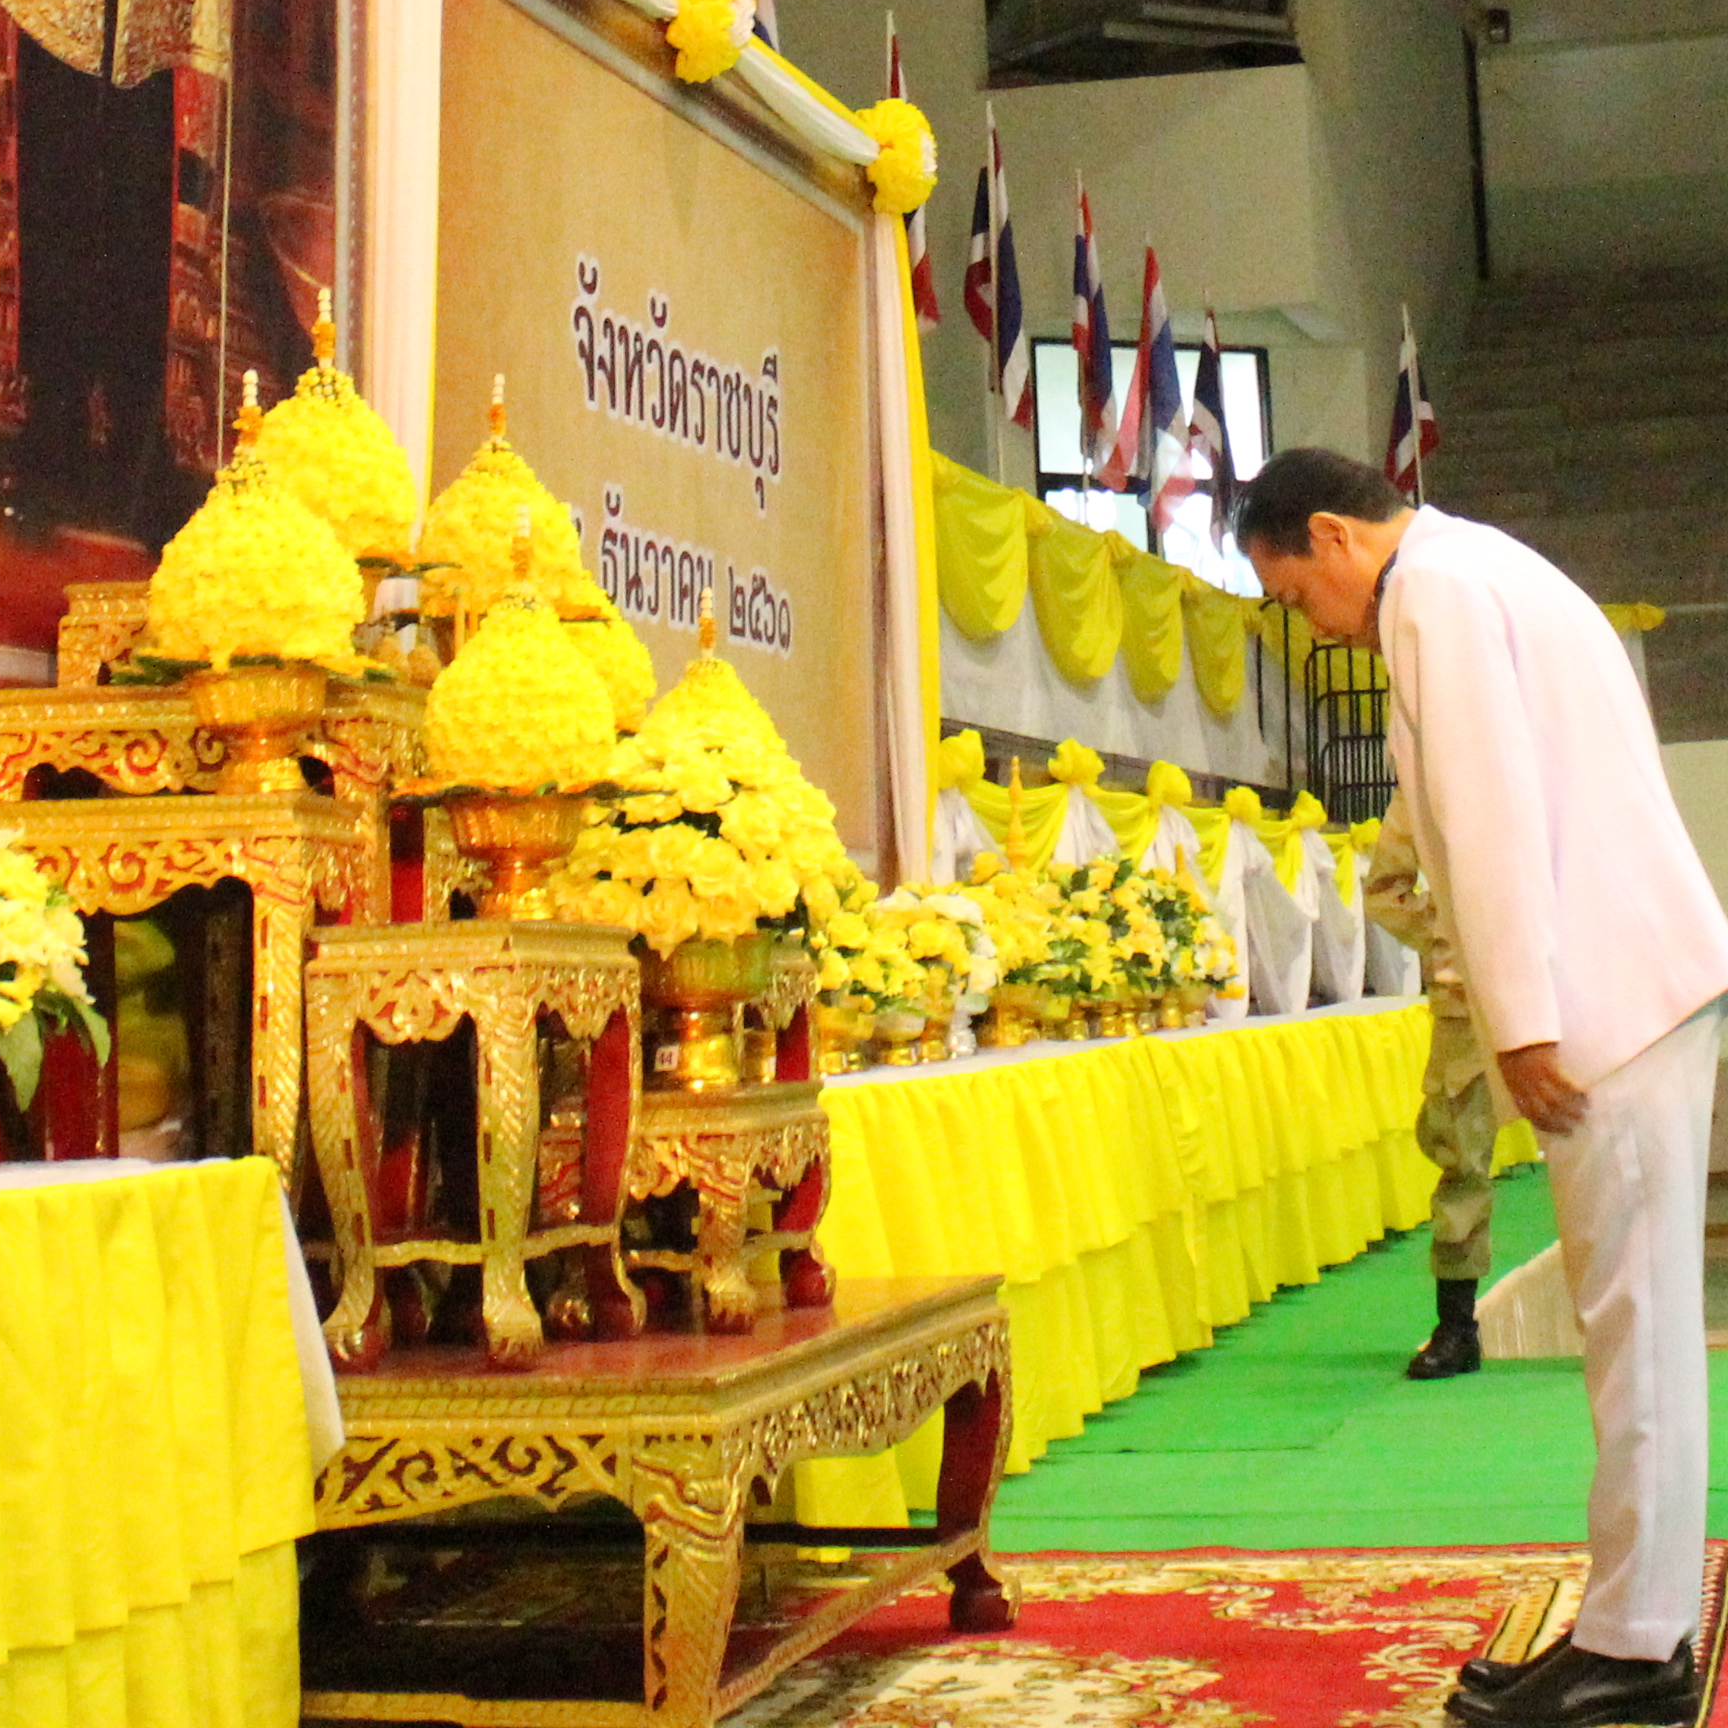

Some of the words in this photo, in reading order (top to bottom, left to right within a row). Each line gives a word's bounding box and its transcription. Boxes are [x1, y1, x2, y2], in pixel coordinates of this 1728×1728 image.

[573, 261, 780, 511] จังหวัดราชบุรี
[728, 566, 792, 653] ๒๕๖๑
